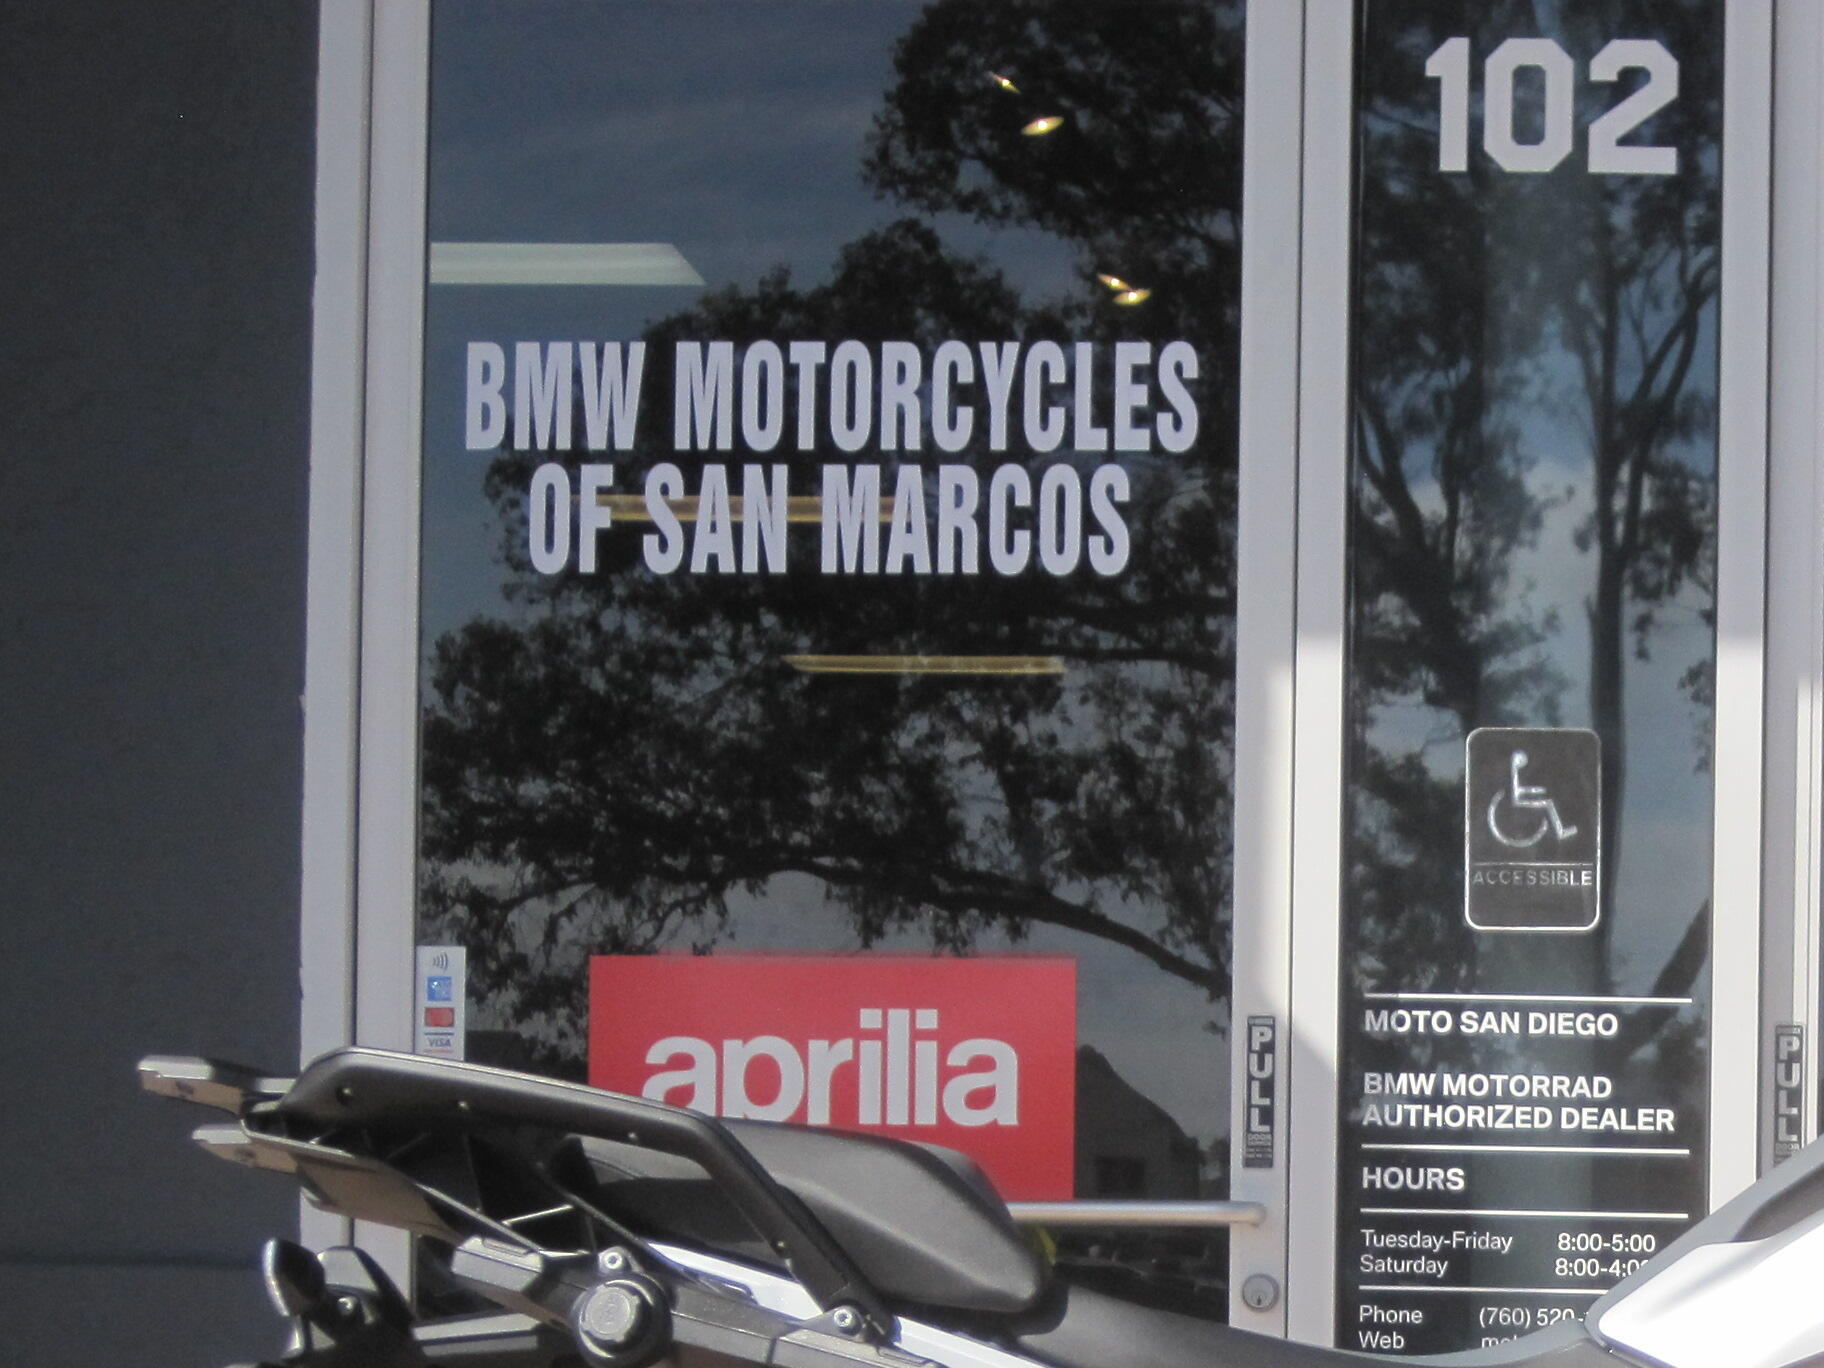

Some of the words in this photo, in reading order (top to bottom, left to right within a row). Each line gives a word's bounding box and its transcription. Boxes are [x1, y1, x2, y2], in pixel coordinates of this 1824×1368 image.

[1425, 37, 1679, 174] 102
[465, 341, 646, 450] BMW
[674, 341, 1199, 453] MOTORCYCLES
[529, 463, 614, 575] OF
[643, 463, 789, 574] SAN
[820, 463, 1130, 575] MARCOS
[1472, 870, 1593, 886] ACCESSIBLE
[1364, 1009, 1453, 1034] MOTO
[1459, 1010, 1521, 1036] SAN
[1528, 1011, 1619, 1037] DIEGO
[642, 1008, 1019, 1126] aprilia
[1250, 1026, 1273, 1132] PULL
[1363, 1072, 1436, 1096] BMW
[1442, 1073, 1613, 1099] MOTORRAD
[1777, 1035, 1801, 1142] PULL
[1362, 1103, 1554, 1130] AUTHORIZED
[1560, 1106, 1676, 1132] DEALER
[1362, 1166, 1466, 1191] HOURS
[1361, 1229, 1513, 1255] Tuesday-Friday
[1557, 1232, 1656, 1253] 8:00-5:00
[1360, 1254, 1449, 1279] Saturday
[1555, 1257, 1648, 1278] 8:00-4:0
[1359, 1304, 1424, 1325] Phone
[1479, 1306, 1532, 1329] (760)
[1358, 1330, 1405, 1350] Web
